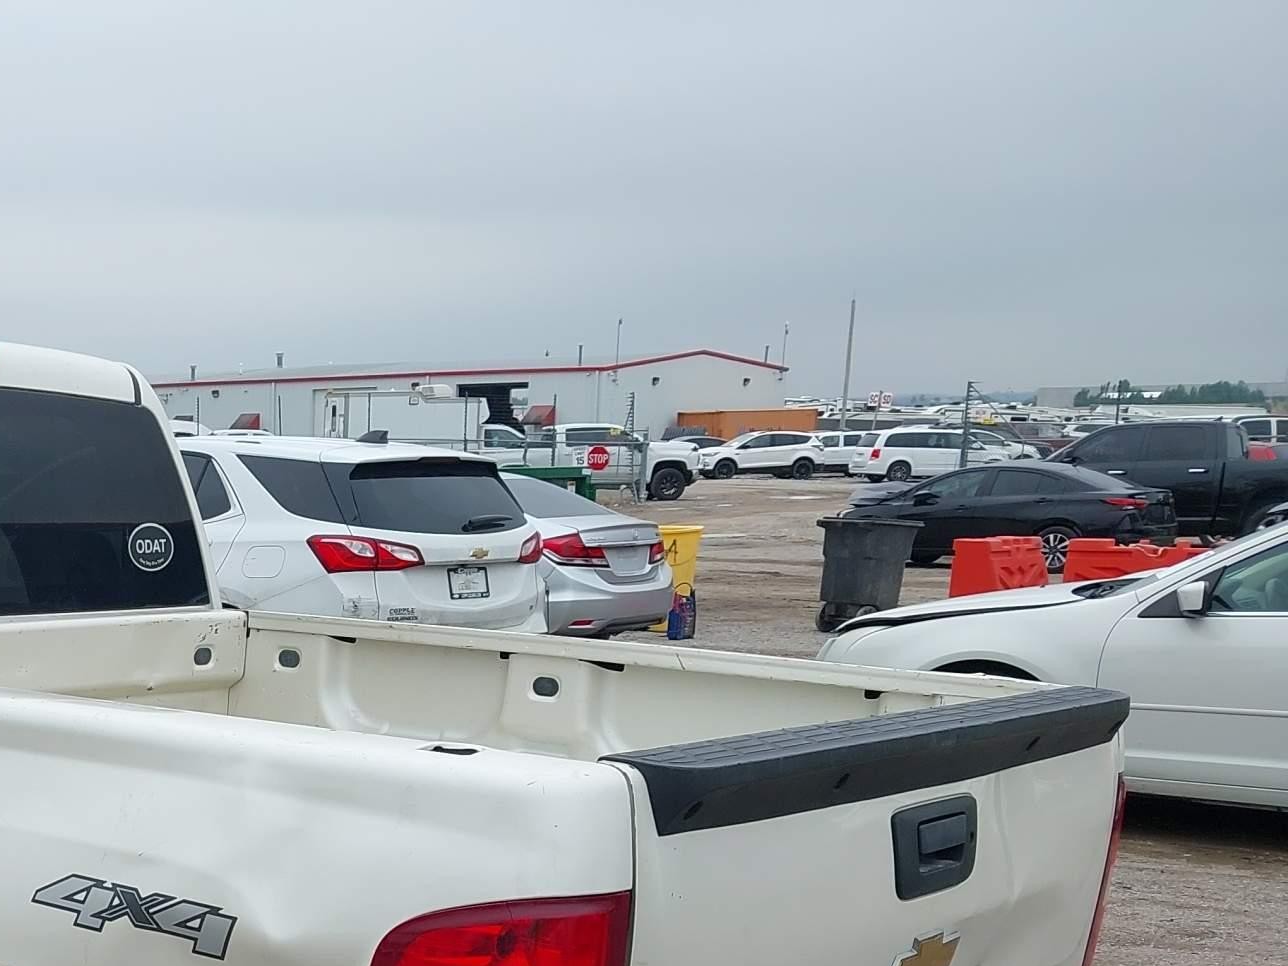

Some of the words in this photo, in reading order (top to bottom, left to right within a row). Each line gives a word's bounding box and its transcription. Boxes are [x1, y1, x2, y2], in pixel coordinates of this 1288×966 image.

[576, 456, 585, 465] 15
[588, 454, 609, 464] STOP
[135, 538, 167, 554] ODAT
